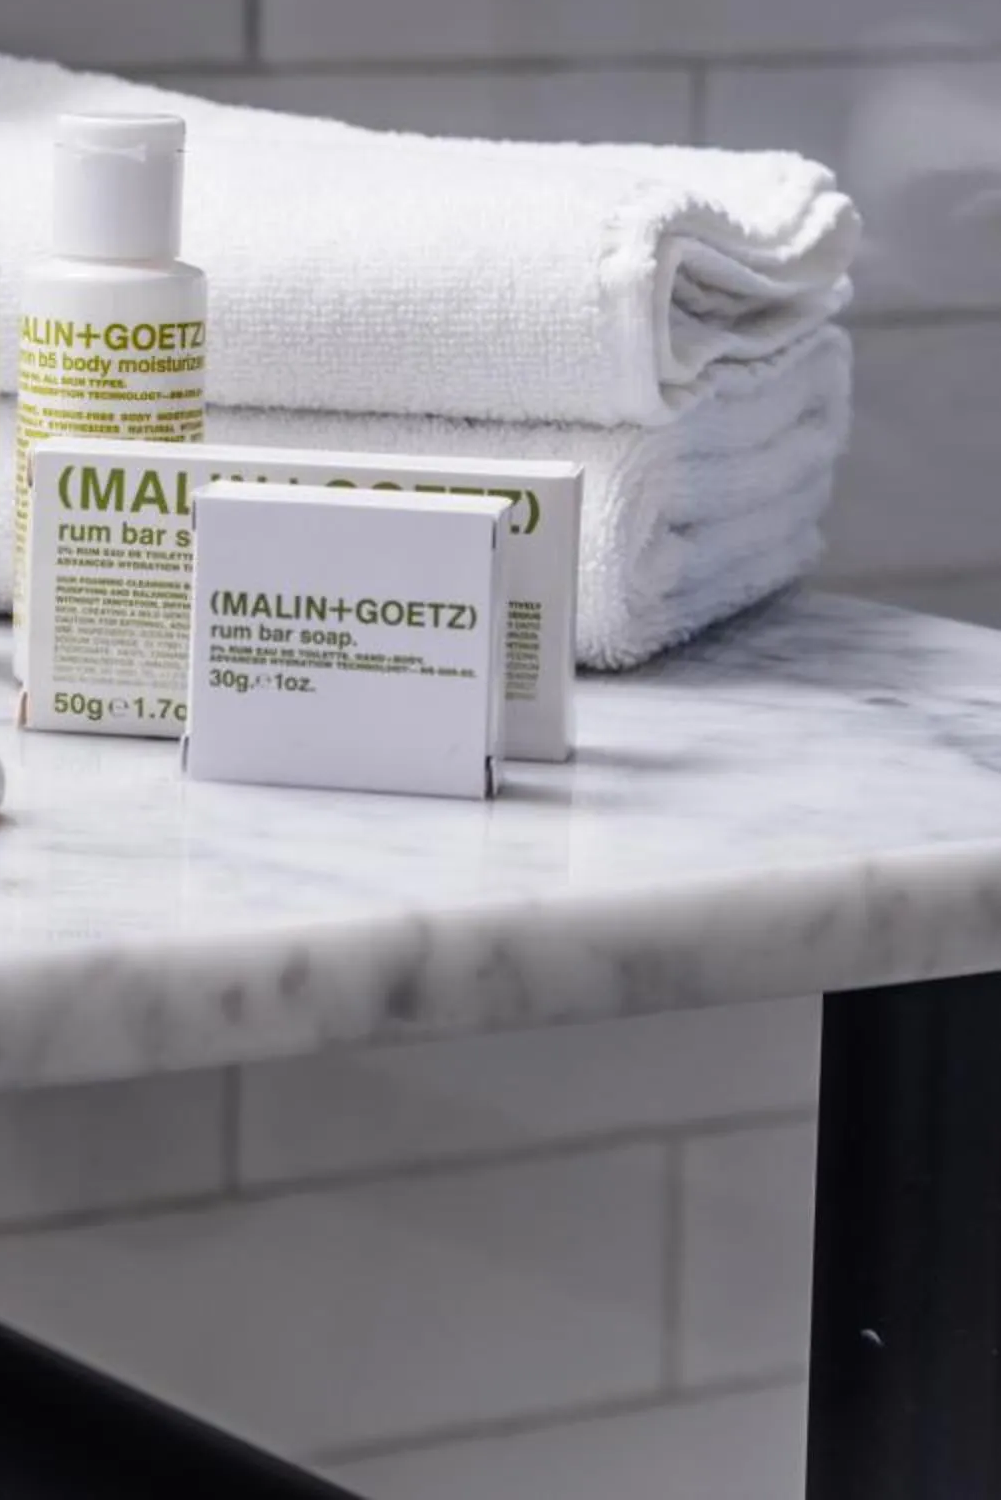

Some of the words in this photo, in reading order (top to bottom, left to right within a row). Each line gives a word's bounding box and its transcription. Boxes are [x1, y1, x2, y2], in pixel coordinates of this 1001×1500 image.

[19, 317, 206, 351] ALIN+GOETZ)
[62, 352, 111, 377] body
[59, 523, 111, 542] rum
[121, 521, 167, 546] bar
[209, 590, 478, 630] (MALIN+GOETZ)
[210, 623, 252, 639] rum
[259, 623, 295, 642] bar
[300, 629, 358, 650] soap.
[55, 692, 103, 721] 50g
[134, 697, 188, 722] 1.7o
